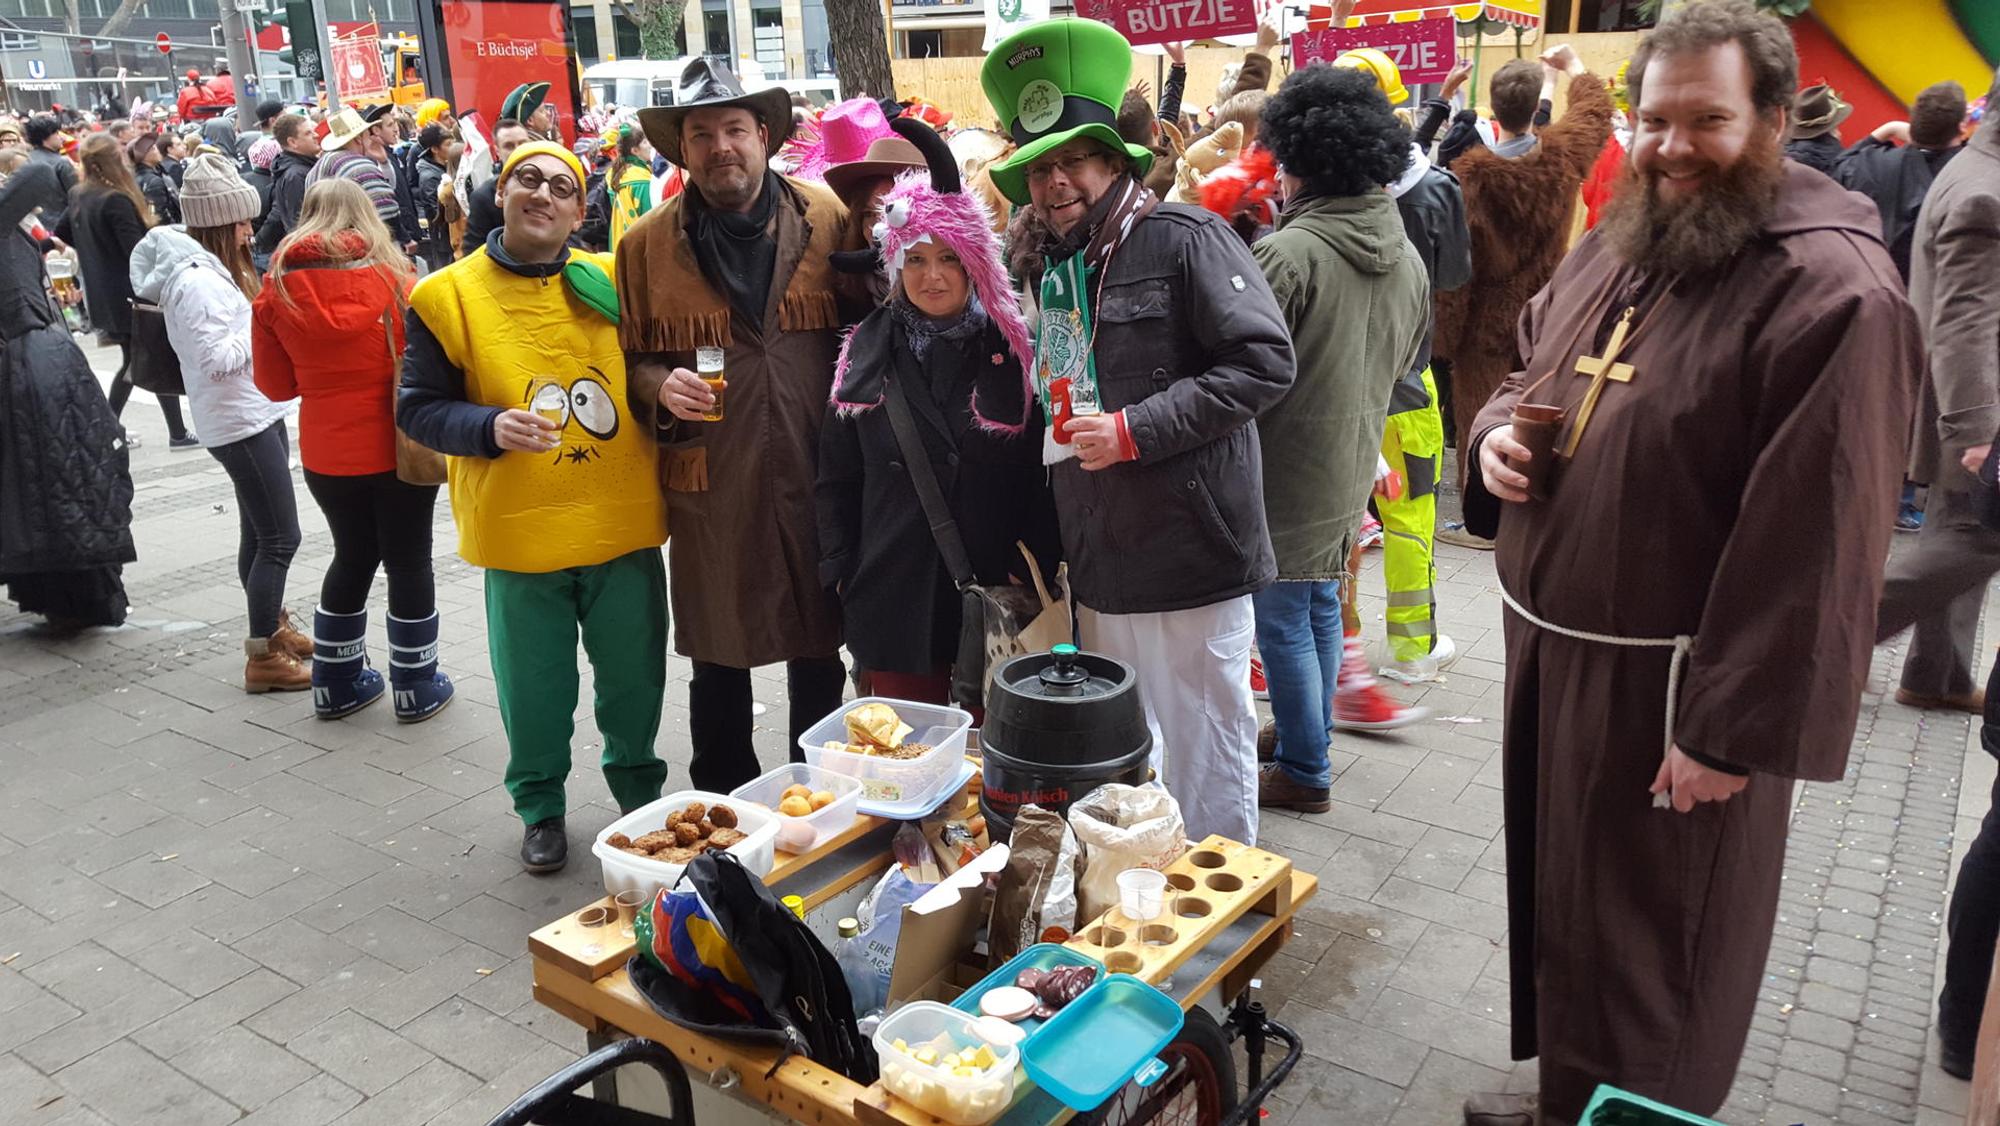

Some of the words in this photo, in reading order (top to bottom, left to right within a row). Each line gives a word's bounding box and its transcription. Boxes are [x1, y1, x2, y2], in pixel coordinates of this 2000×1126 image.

[1126, 0, 1237, 34] BÜTZJE
[477, 42, 486, 56] E
[488, 41, 537, 61] Büchsje!
[28, 60, 46, 79] U
[868, 940, 893, 957] EINE
